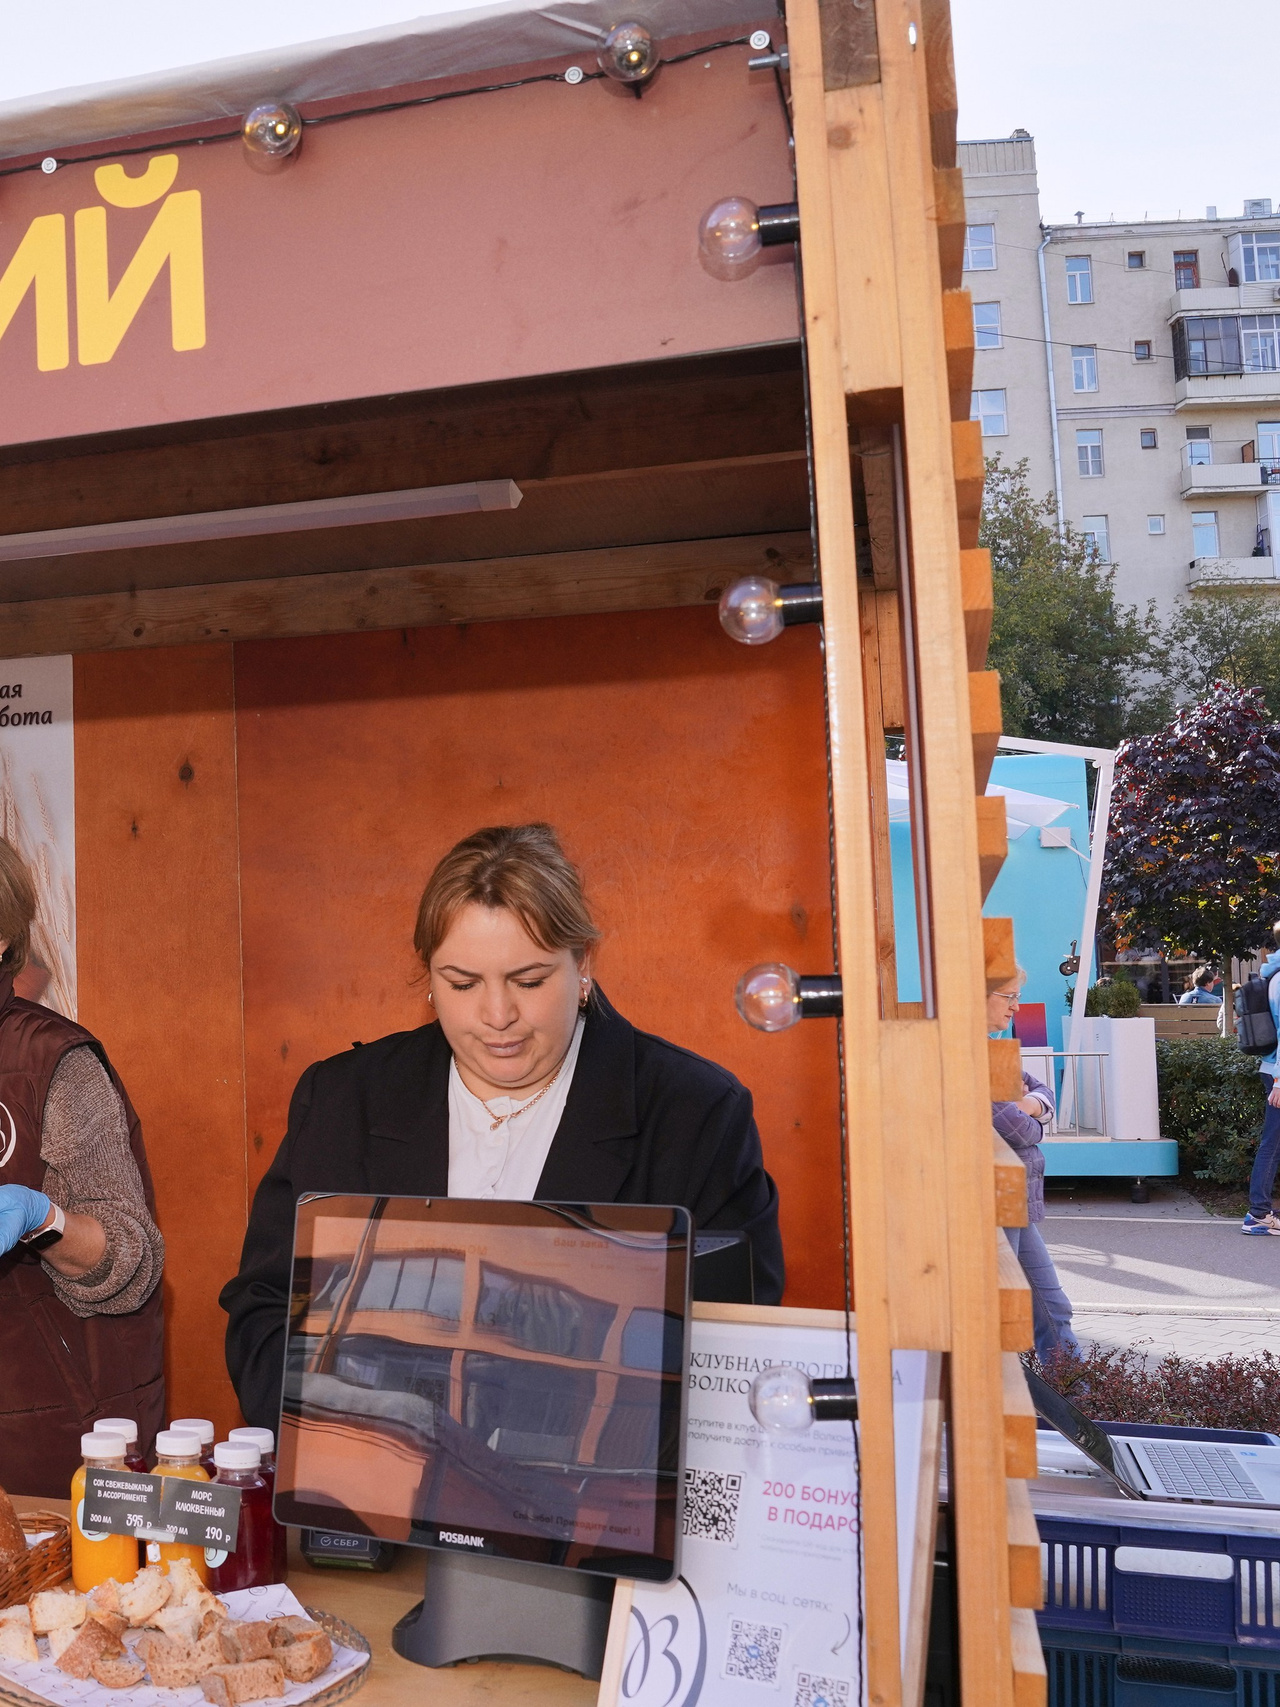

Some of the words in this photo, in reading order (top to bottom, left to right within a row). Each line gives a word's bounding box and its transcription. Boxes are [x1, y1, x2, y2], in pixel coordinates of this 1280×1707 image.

[689, 1351, 773, 1374] КЛУБНАЯ
[687, 1418, 725, 1430] ступите
[93, 1478, 105, 1487] СОК
[97, 1489, 102, 1498] В
[103, 1491, 148, 1503] АССОРТИМЕНТЕ
[191, 1490, 213, 1502] МОРС
[762, 1480, 795, 1499] 200
[801, 1485, 862, 1509] БОНУС
[175, 1501, 226, 1518] КЛЮКВЕННЫЙ
[768, 1506, 778, 1521] В
[90, 1513, 102, 1523] 300
[126, 1513, 143, 1528] 395
[205, 1526, 223, 1541] 190
[438, 1530, 485, 1548] POSBANK
[333, 1538, 359, 1547] СБЕР
[726, 1582, 746, 1597] Мы
